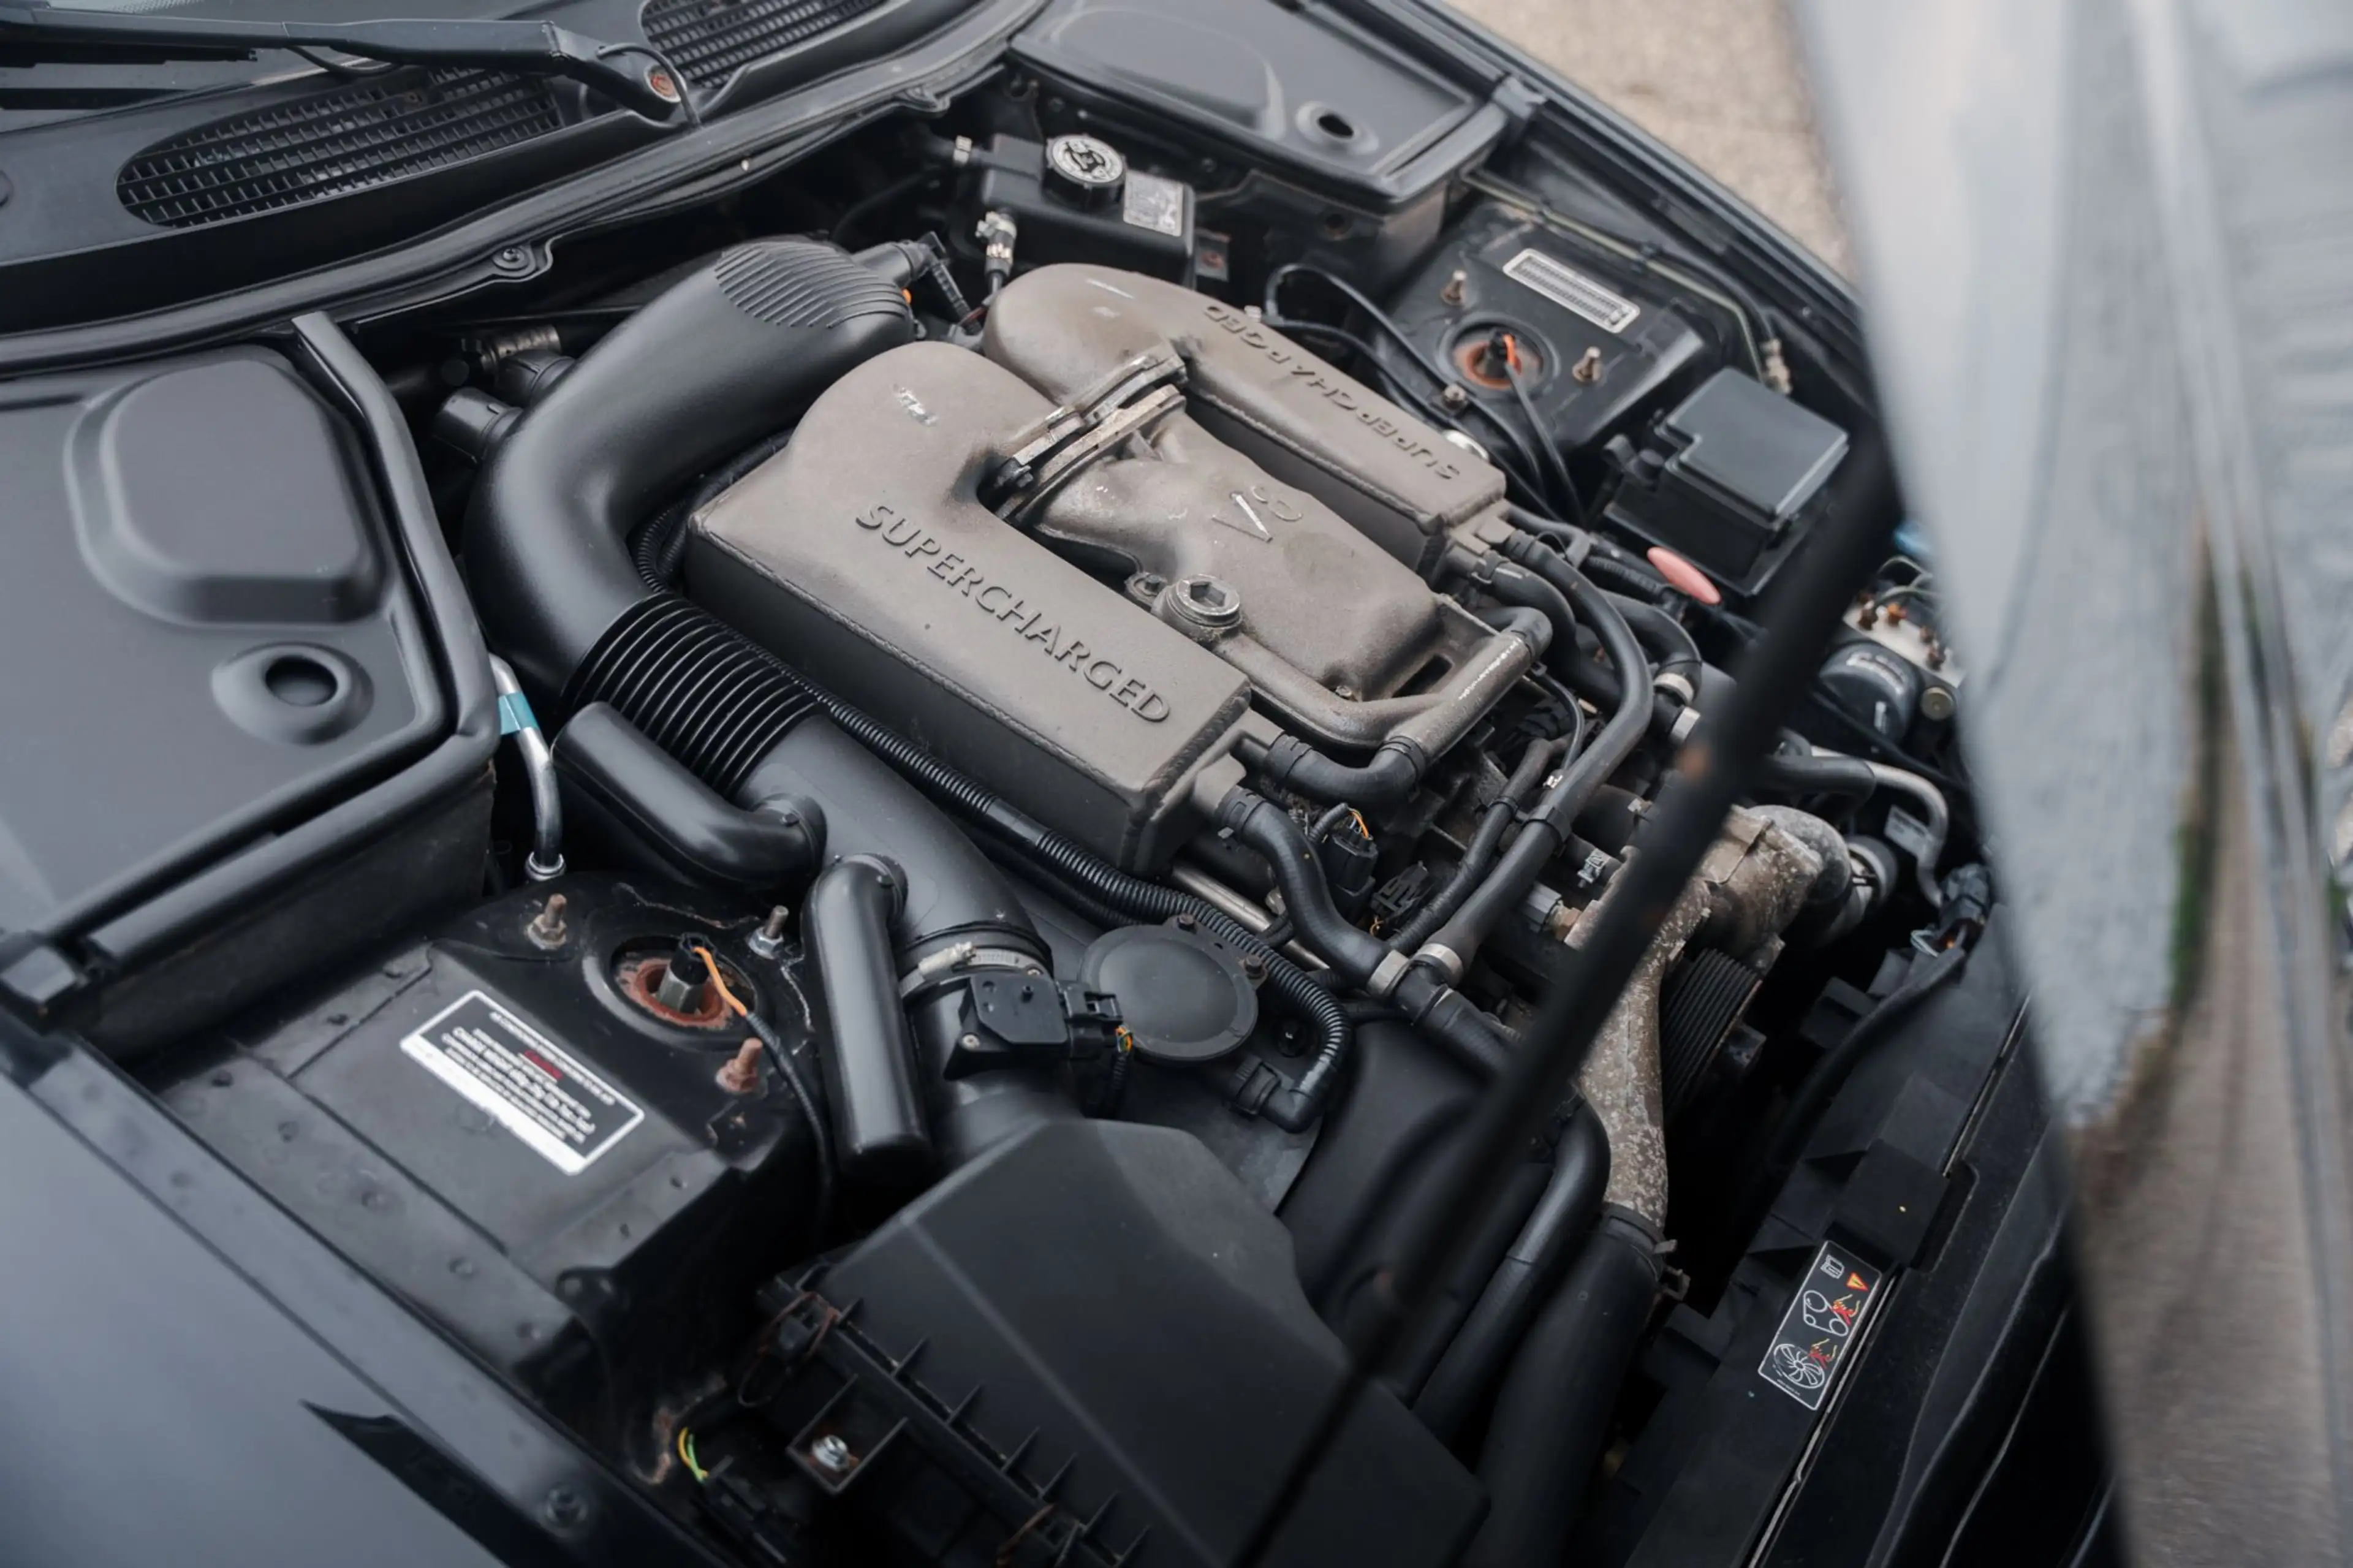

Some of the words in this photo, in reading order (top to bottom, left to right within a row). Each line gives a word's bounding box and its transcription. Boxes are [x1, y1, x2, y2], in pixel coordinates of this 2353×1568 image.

[1203, 306, 1461, 480] SUPERCHARGED
[1211, 485, 1304, 543] V8
[855, 505, 1170, 723] SUPERCHARGED
